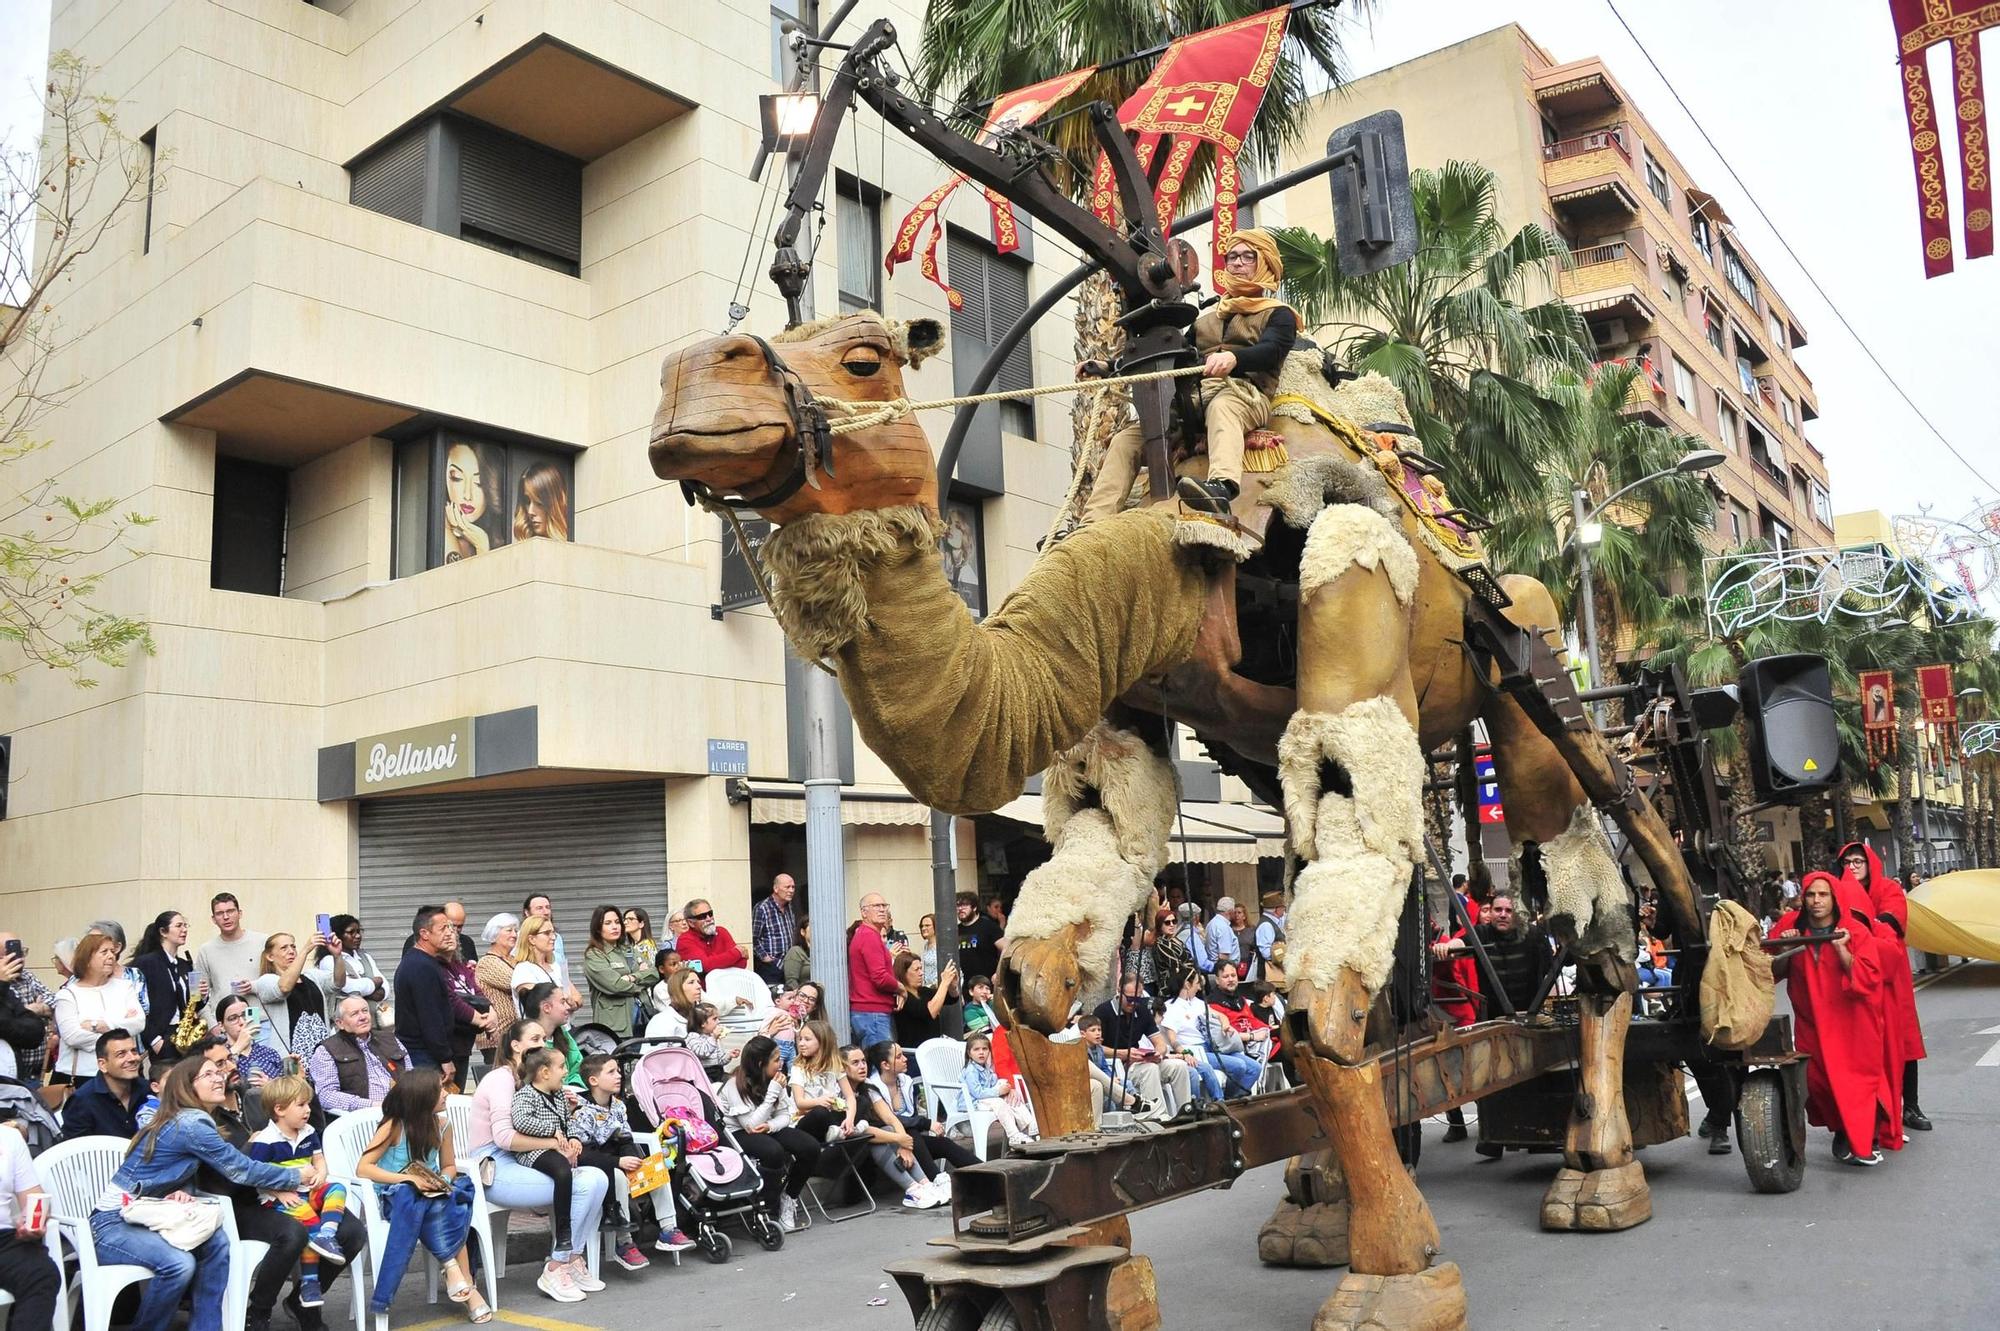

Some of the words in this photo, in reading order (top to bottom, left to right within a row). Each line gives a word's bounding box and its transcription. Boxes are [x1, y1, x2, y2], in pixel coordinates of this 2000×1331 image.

[716, 741, 745, 751] CARRER
[365, 733, 457, 783] Bellasoi
[711, 760, 746, 773] ALICANTE
